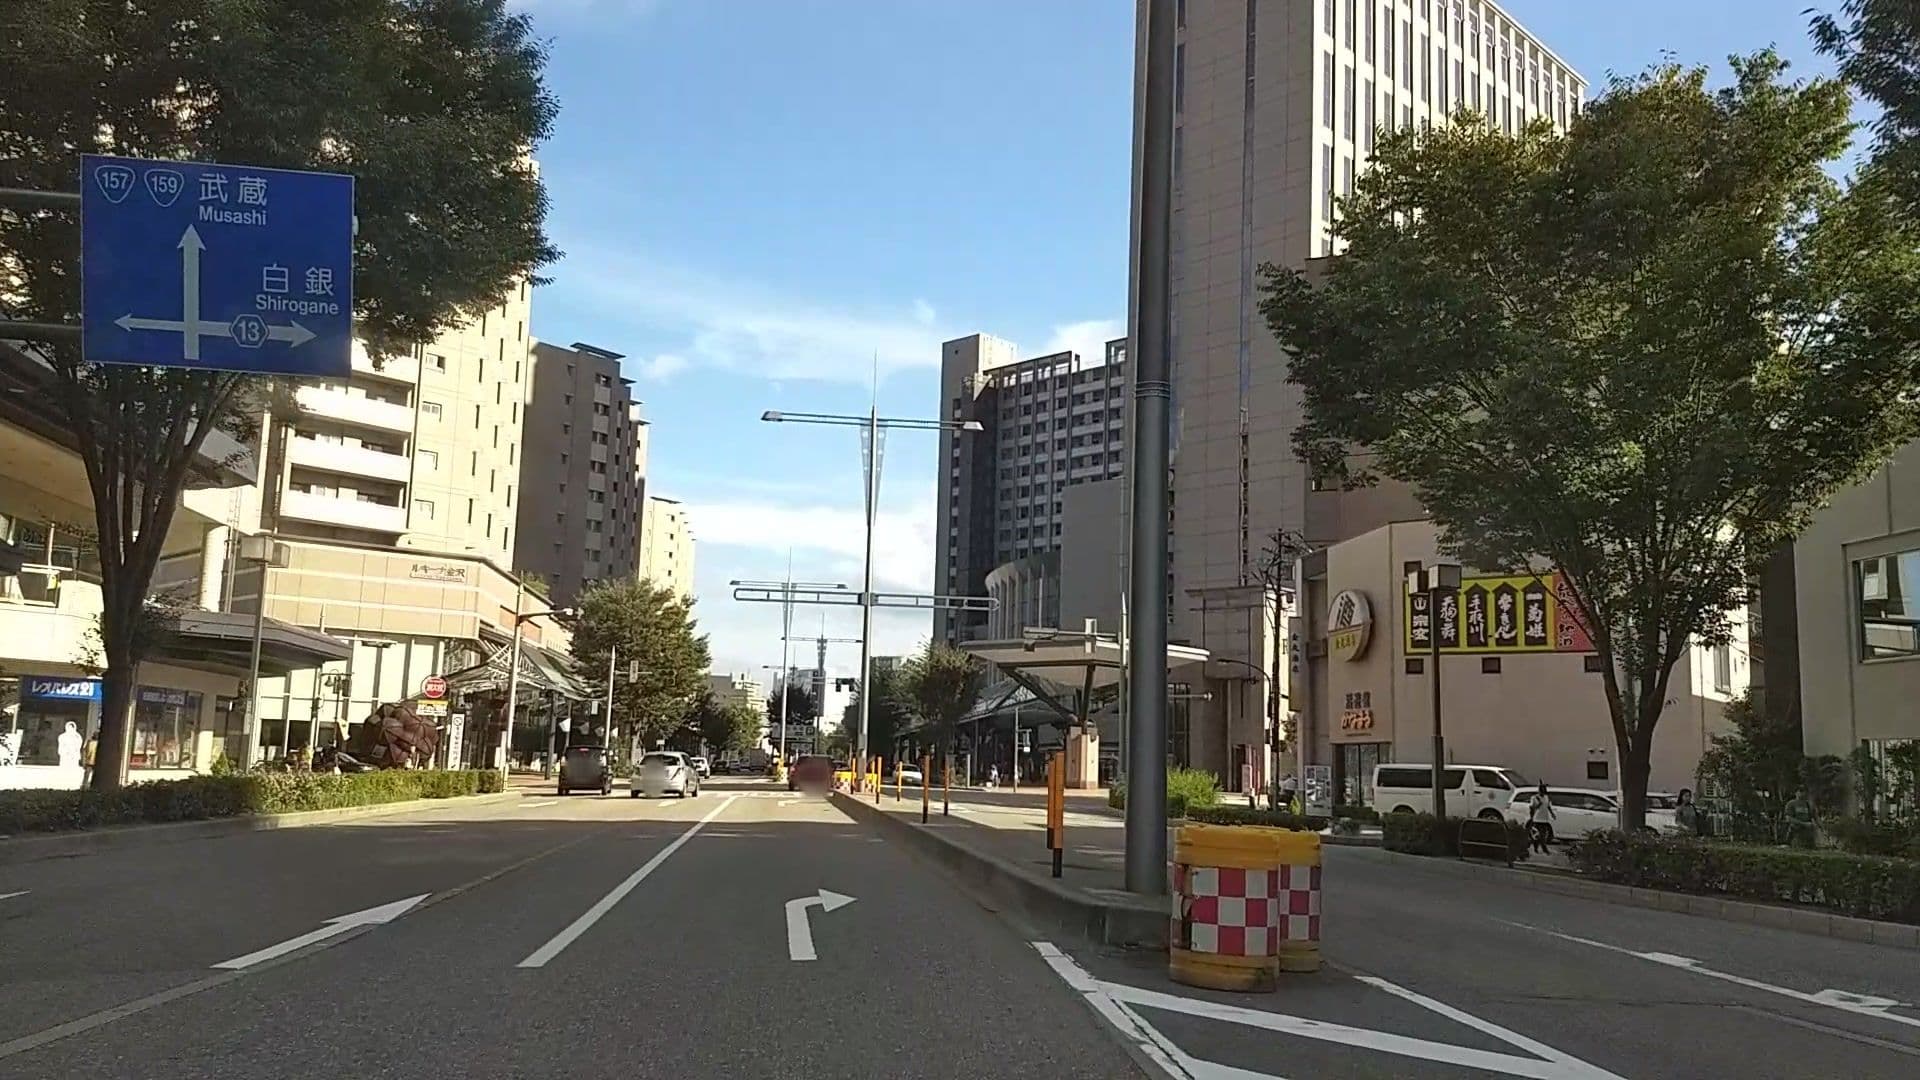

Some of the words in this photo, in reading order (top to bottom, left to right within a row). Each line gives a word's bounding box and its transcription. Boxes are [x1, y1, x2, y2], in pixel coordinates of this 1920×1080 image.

[102, 173, 128, 190] 157
[151, 176, 177, 194] 159
[199, 172, 268, 206] 武蔵
[199, 205, 267, 226] Musashi
[262, 263, 333, 297] 白銀
[255, 294, 339, 316] Shirogane
[237, 321, 260, 342] 13
